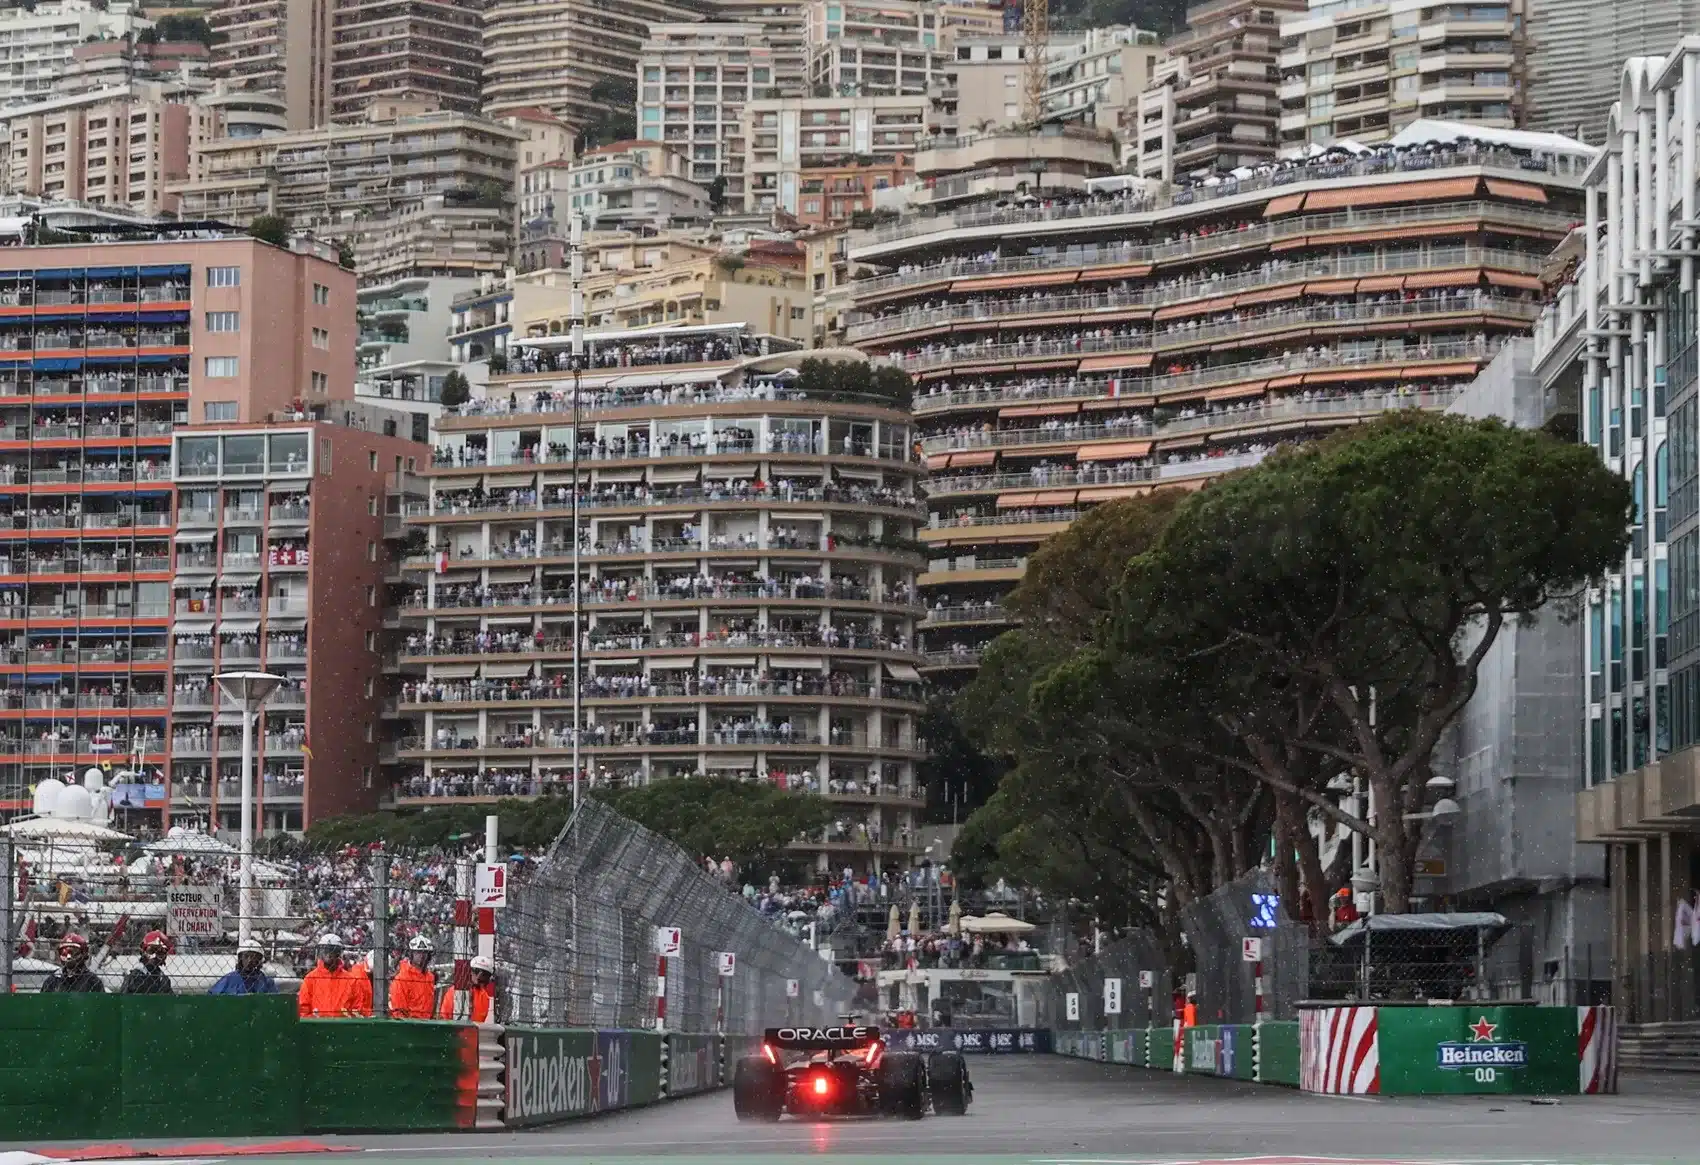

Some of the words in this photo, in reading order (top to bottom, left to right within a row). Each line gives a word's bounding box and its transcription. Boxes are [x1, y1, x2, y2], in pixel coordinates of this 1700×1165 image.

[171, 893, 202, 902] SECTEUR
[172, 908, 218, 917] INTERVENTION
[777, 1027, 867, 1041] ORACLE
[916, 1033, 939, 1046] MSC
[963, 1033, 982, 1046] MSC
[1441, 1046, 1524, 1063] Heineken
[508, 1036, 585, 1119] Heineken
